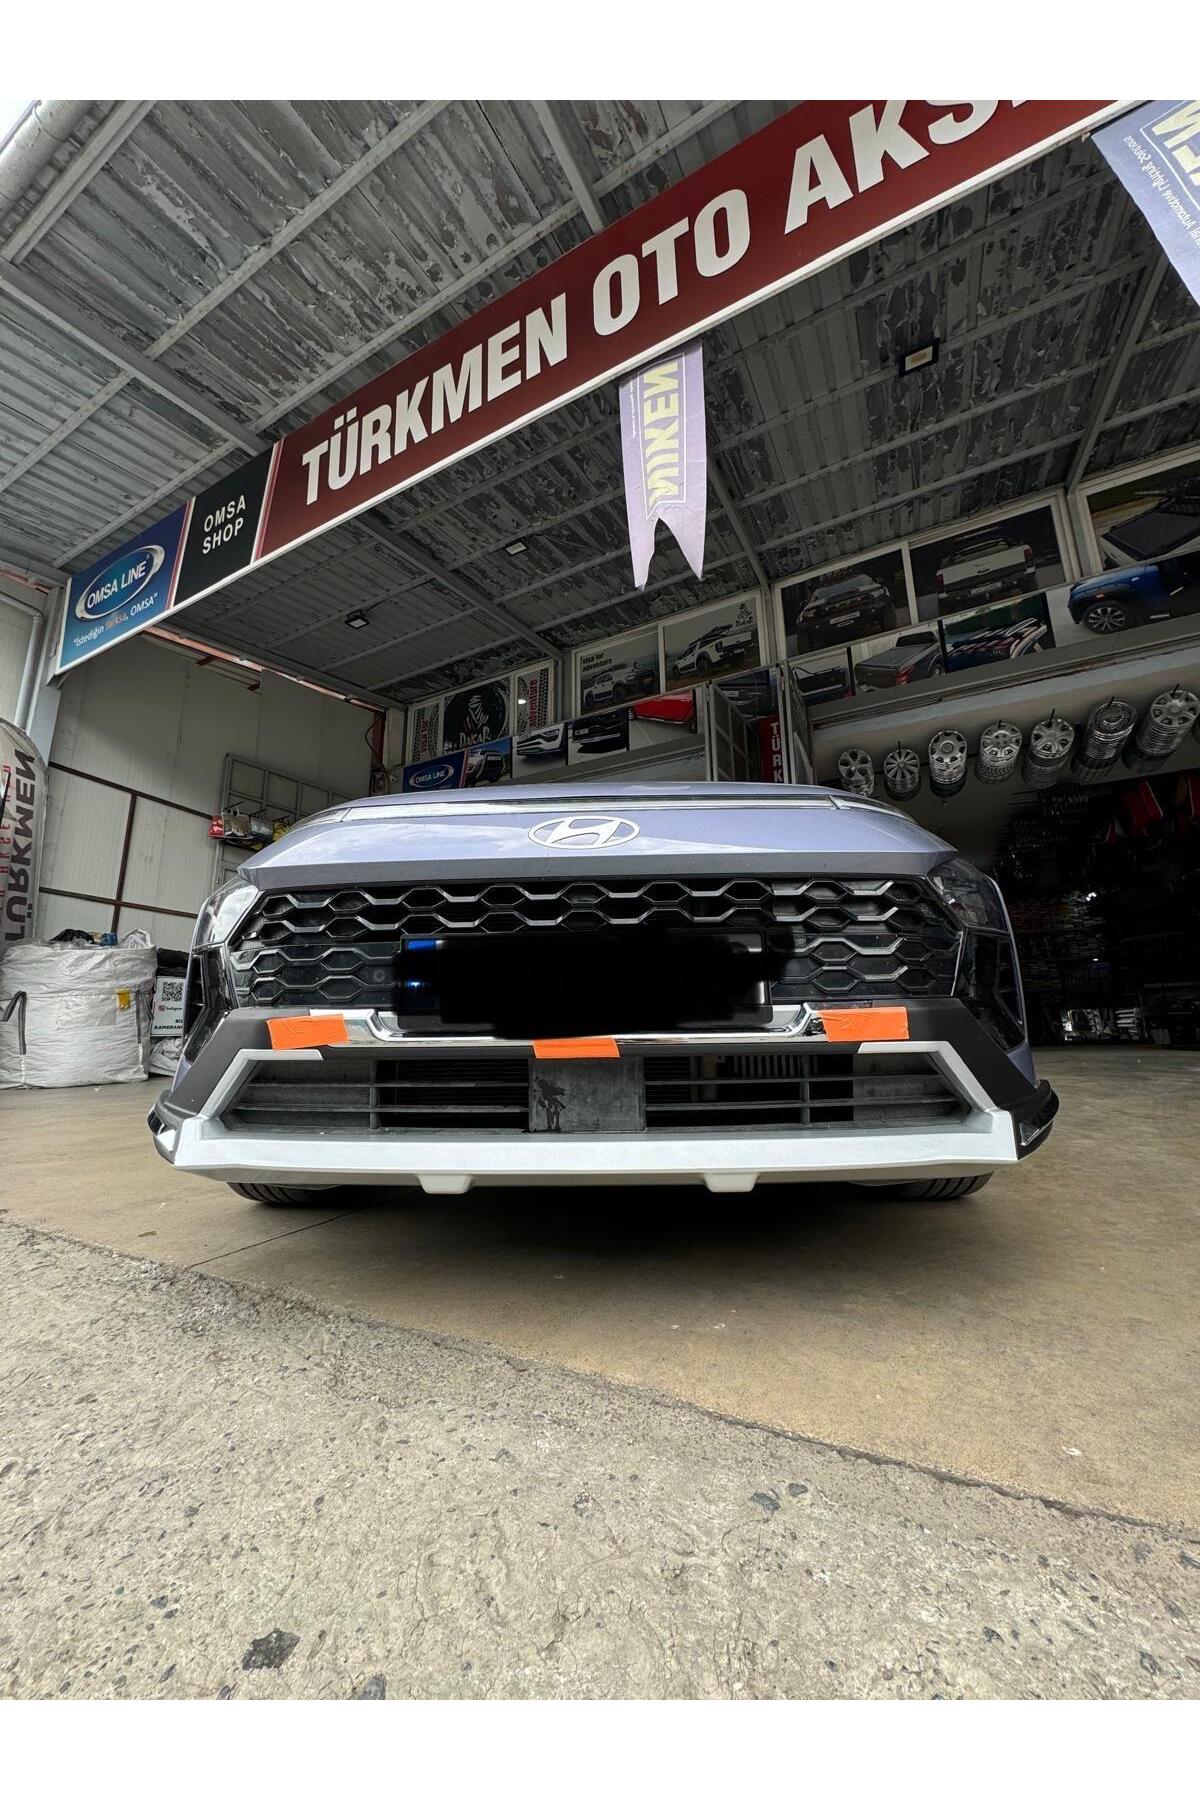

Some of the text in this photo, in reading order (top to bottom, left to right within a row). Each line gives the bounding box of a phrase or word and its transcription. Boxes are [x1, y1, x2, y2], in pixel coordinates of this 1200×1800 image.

[302, 292, 567, 505] TÜRKMEN
[593, 188, 750, 336] OTO
[784, 100, 1028, 236] AKS
[203, 494, 247, 533] OMSA
[202, 517, 244, 555] SHOP
[87, 560, 147, 609] OMSA LINE
[415, 773, 432, 784] OMSA
